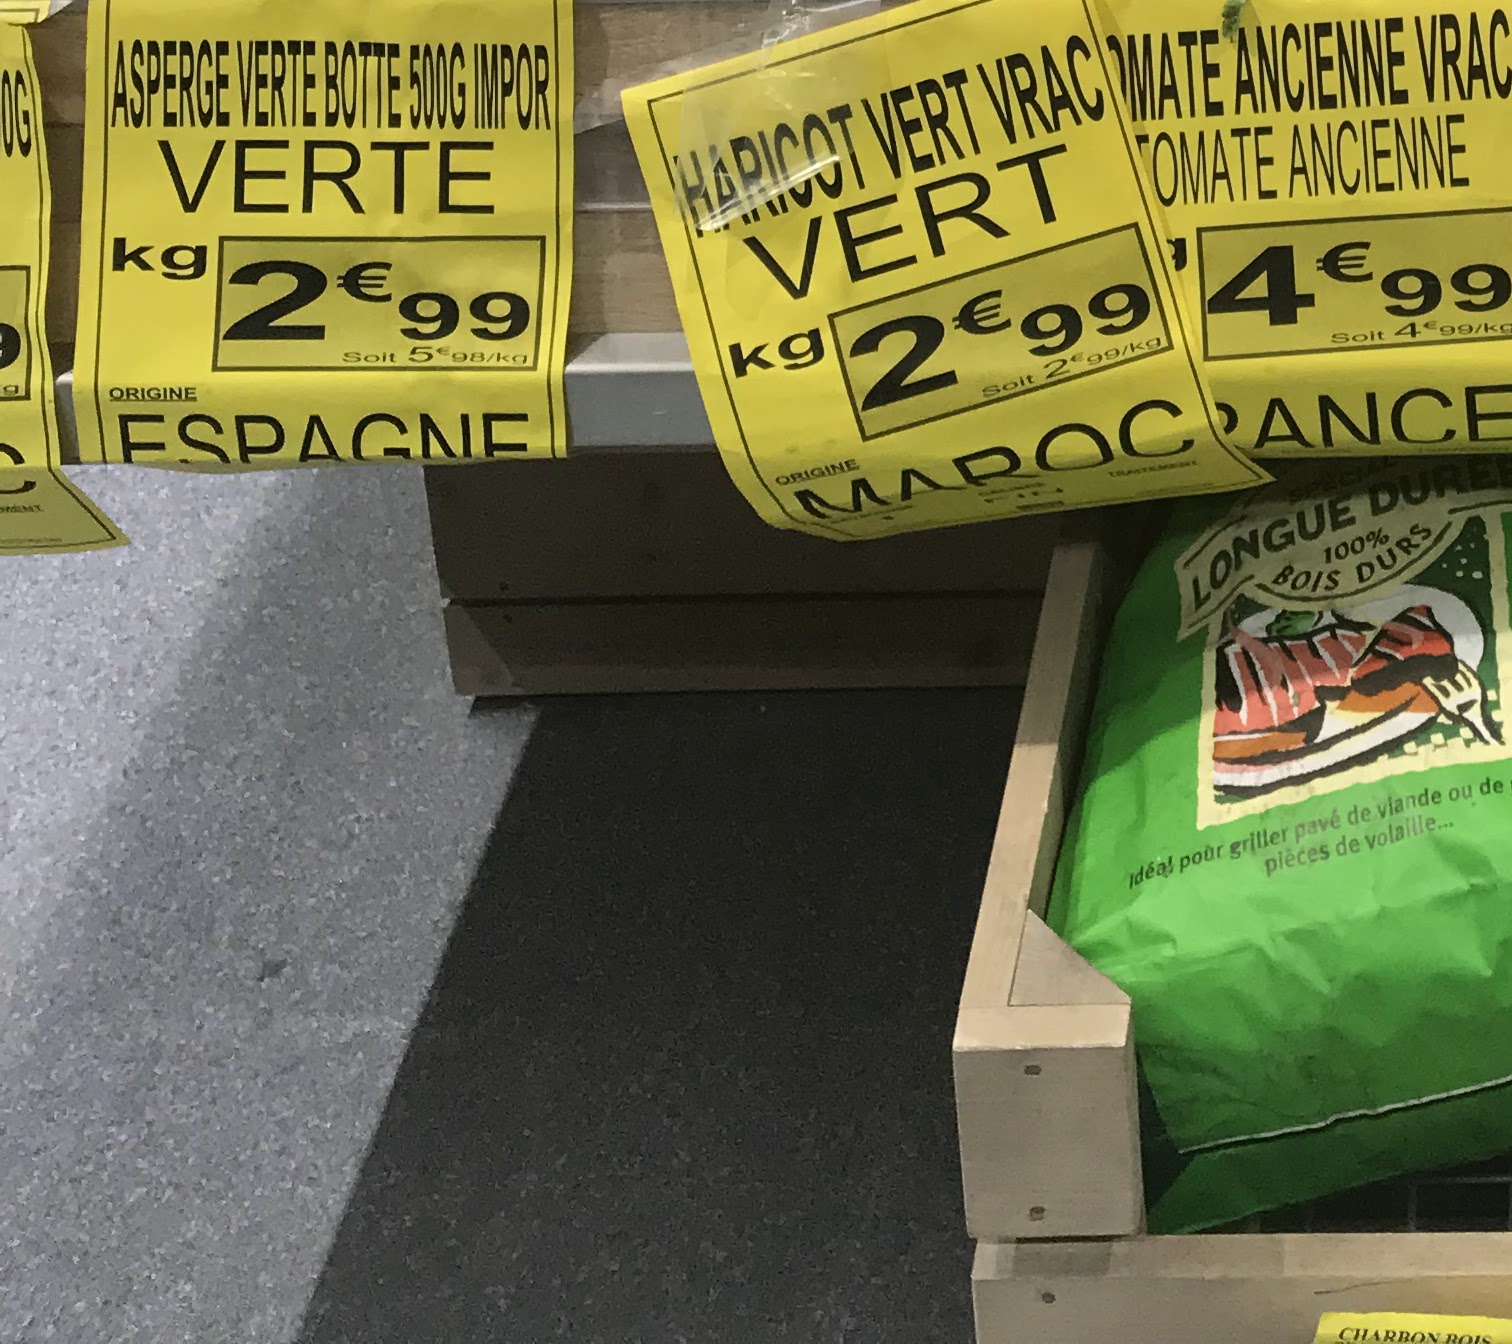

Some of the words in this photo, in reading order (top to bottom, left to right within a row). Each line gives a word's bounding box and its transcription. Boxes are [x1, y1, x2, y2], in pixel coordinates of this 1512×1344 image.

[111, 39, 230, 129] ASPERGE
[237, 39, 318, 129] VERTE
[324, 39, 401, 129] BOTTE
[409, 41, 466, 130] 500G
[473, 43, 551, 131] IMPOR
[1106, 29, 1224, 123] OMATE
[1234, 17, 1409, 115] ANCIENNE
[674, 103, 865, 238] HARICOT
[861, 68, 984, 179] VERT
[976, 34, 1104, 145] VRAC
[1289, 113, 1470, 199] ANCIENNE
[157, 139, 496, 215] VERTE
[743, 143, 1069, 300] VERT
[112, 237, 208, 280] kg
[342, 350, 396, 365] Soit
[728, 324, 826, 378] kg
[1330, 329, 1385, 345] Soit
[109, 387, 197, 401] ORIGINE
[981, 372, 1035, 398] Soit
[117, 412, 531, 464] ESPAGNE
[794, 399, 1196, 520] MAROC
[775, 458, 860, 486] ORIGINE
[1192, 497, 1356, 610] LONGUE
[1272, 566, 1340, 593] BOIS
[1357, 524, 1432, 584] DURS
[1324, 527, 1390, 564] 100%
[1128, 857, 1174, 890] Idéal
[1178, 844, 1223, 876] pour
[1229, 826, 1289, 860] griller
[1295, 809, 1342, 843] pavé
[1348, 802, 1372, 825] de
[1377, 787, 1442, 823] viande
[1448, 784, 1473, 802] ou
[1479, 776, 1504, 796] de
[1264, 842, 1330, 878] pièces
[1336, 837, 1360, 858] de
[1338, 1327, 1441, 1344] CHARBON
[1444, 1333, 1492, 1344] BOIS
